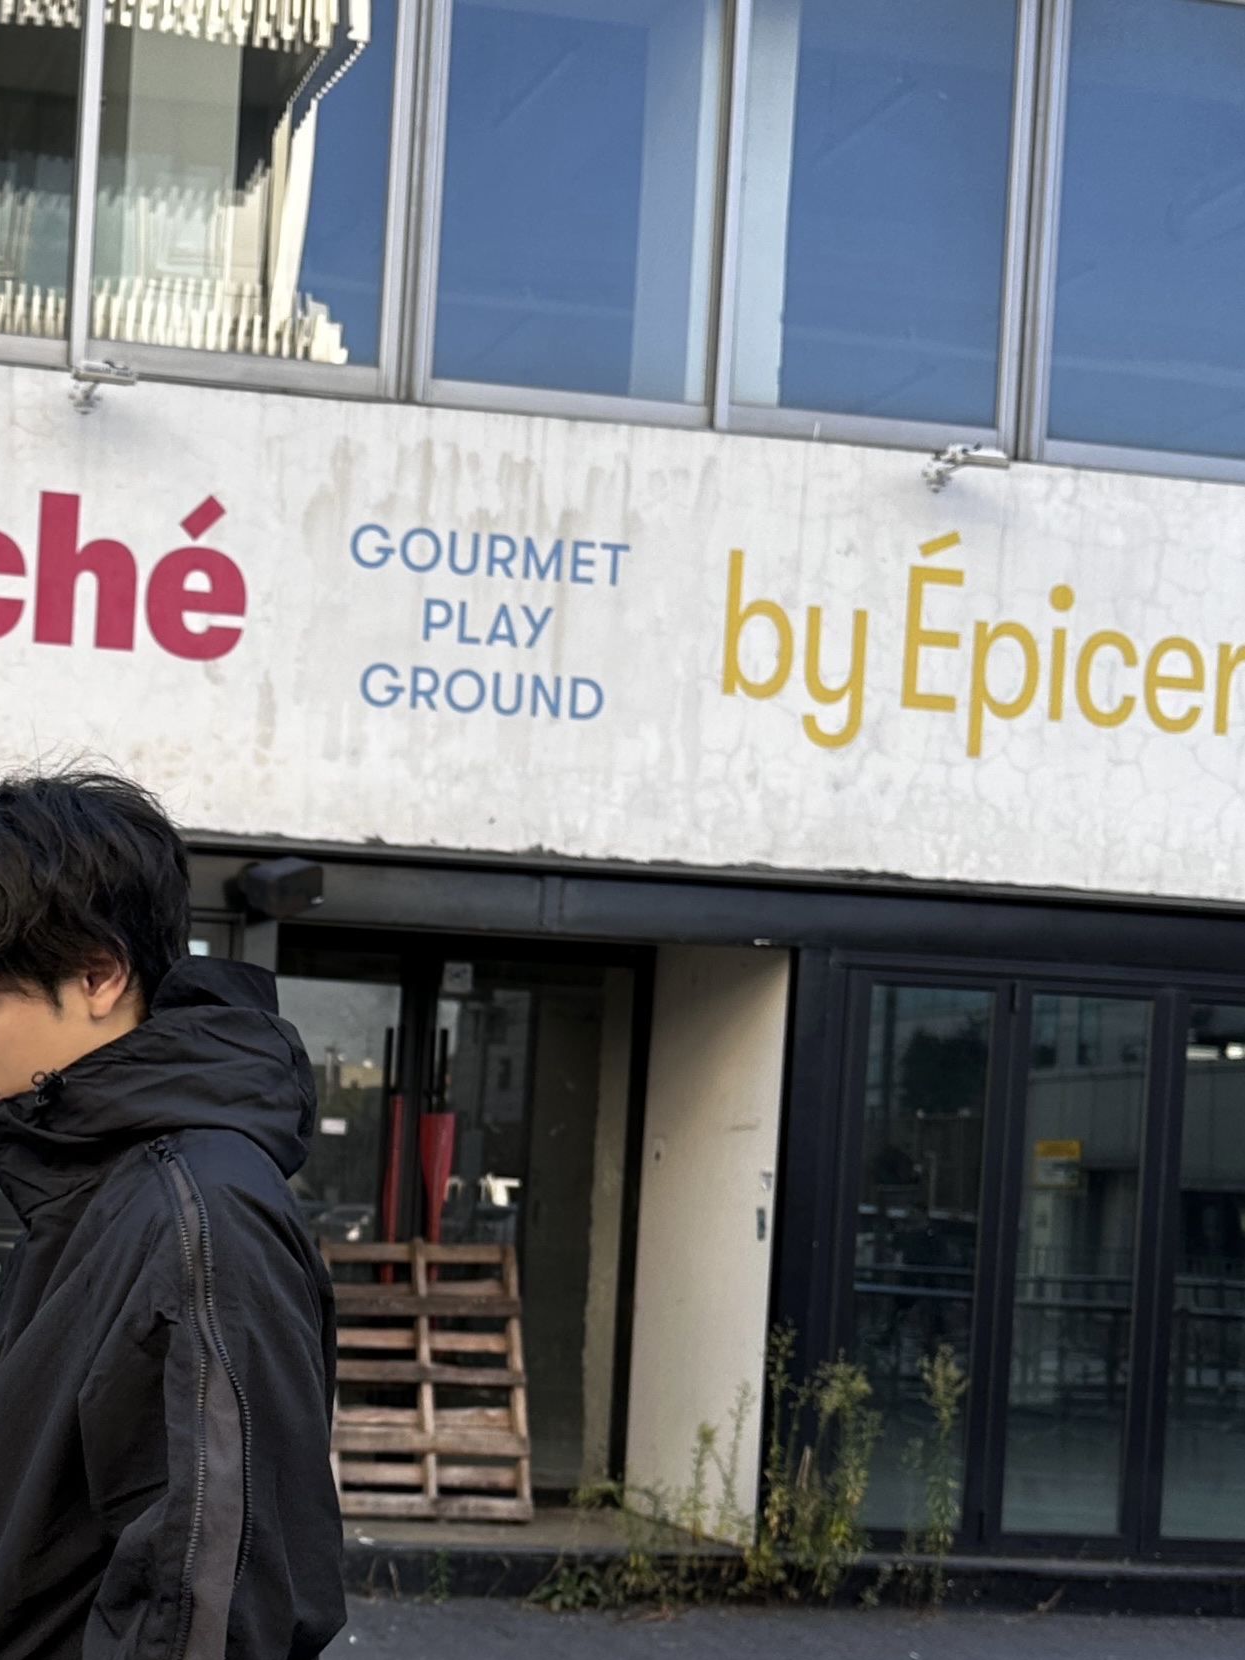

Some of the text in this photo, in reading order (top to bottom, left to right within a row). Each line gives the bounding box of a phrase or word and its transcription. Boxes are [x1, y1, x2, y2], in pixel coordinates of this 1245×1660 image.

[350, 523, 631, 588] GOURMET
[421, 597, 554, 650] PLAY
[721, 529, 1245, 758] by Épicer
[359, 661, 605, 721] GROUND
